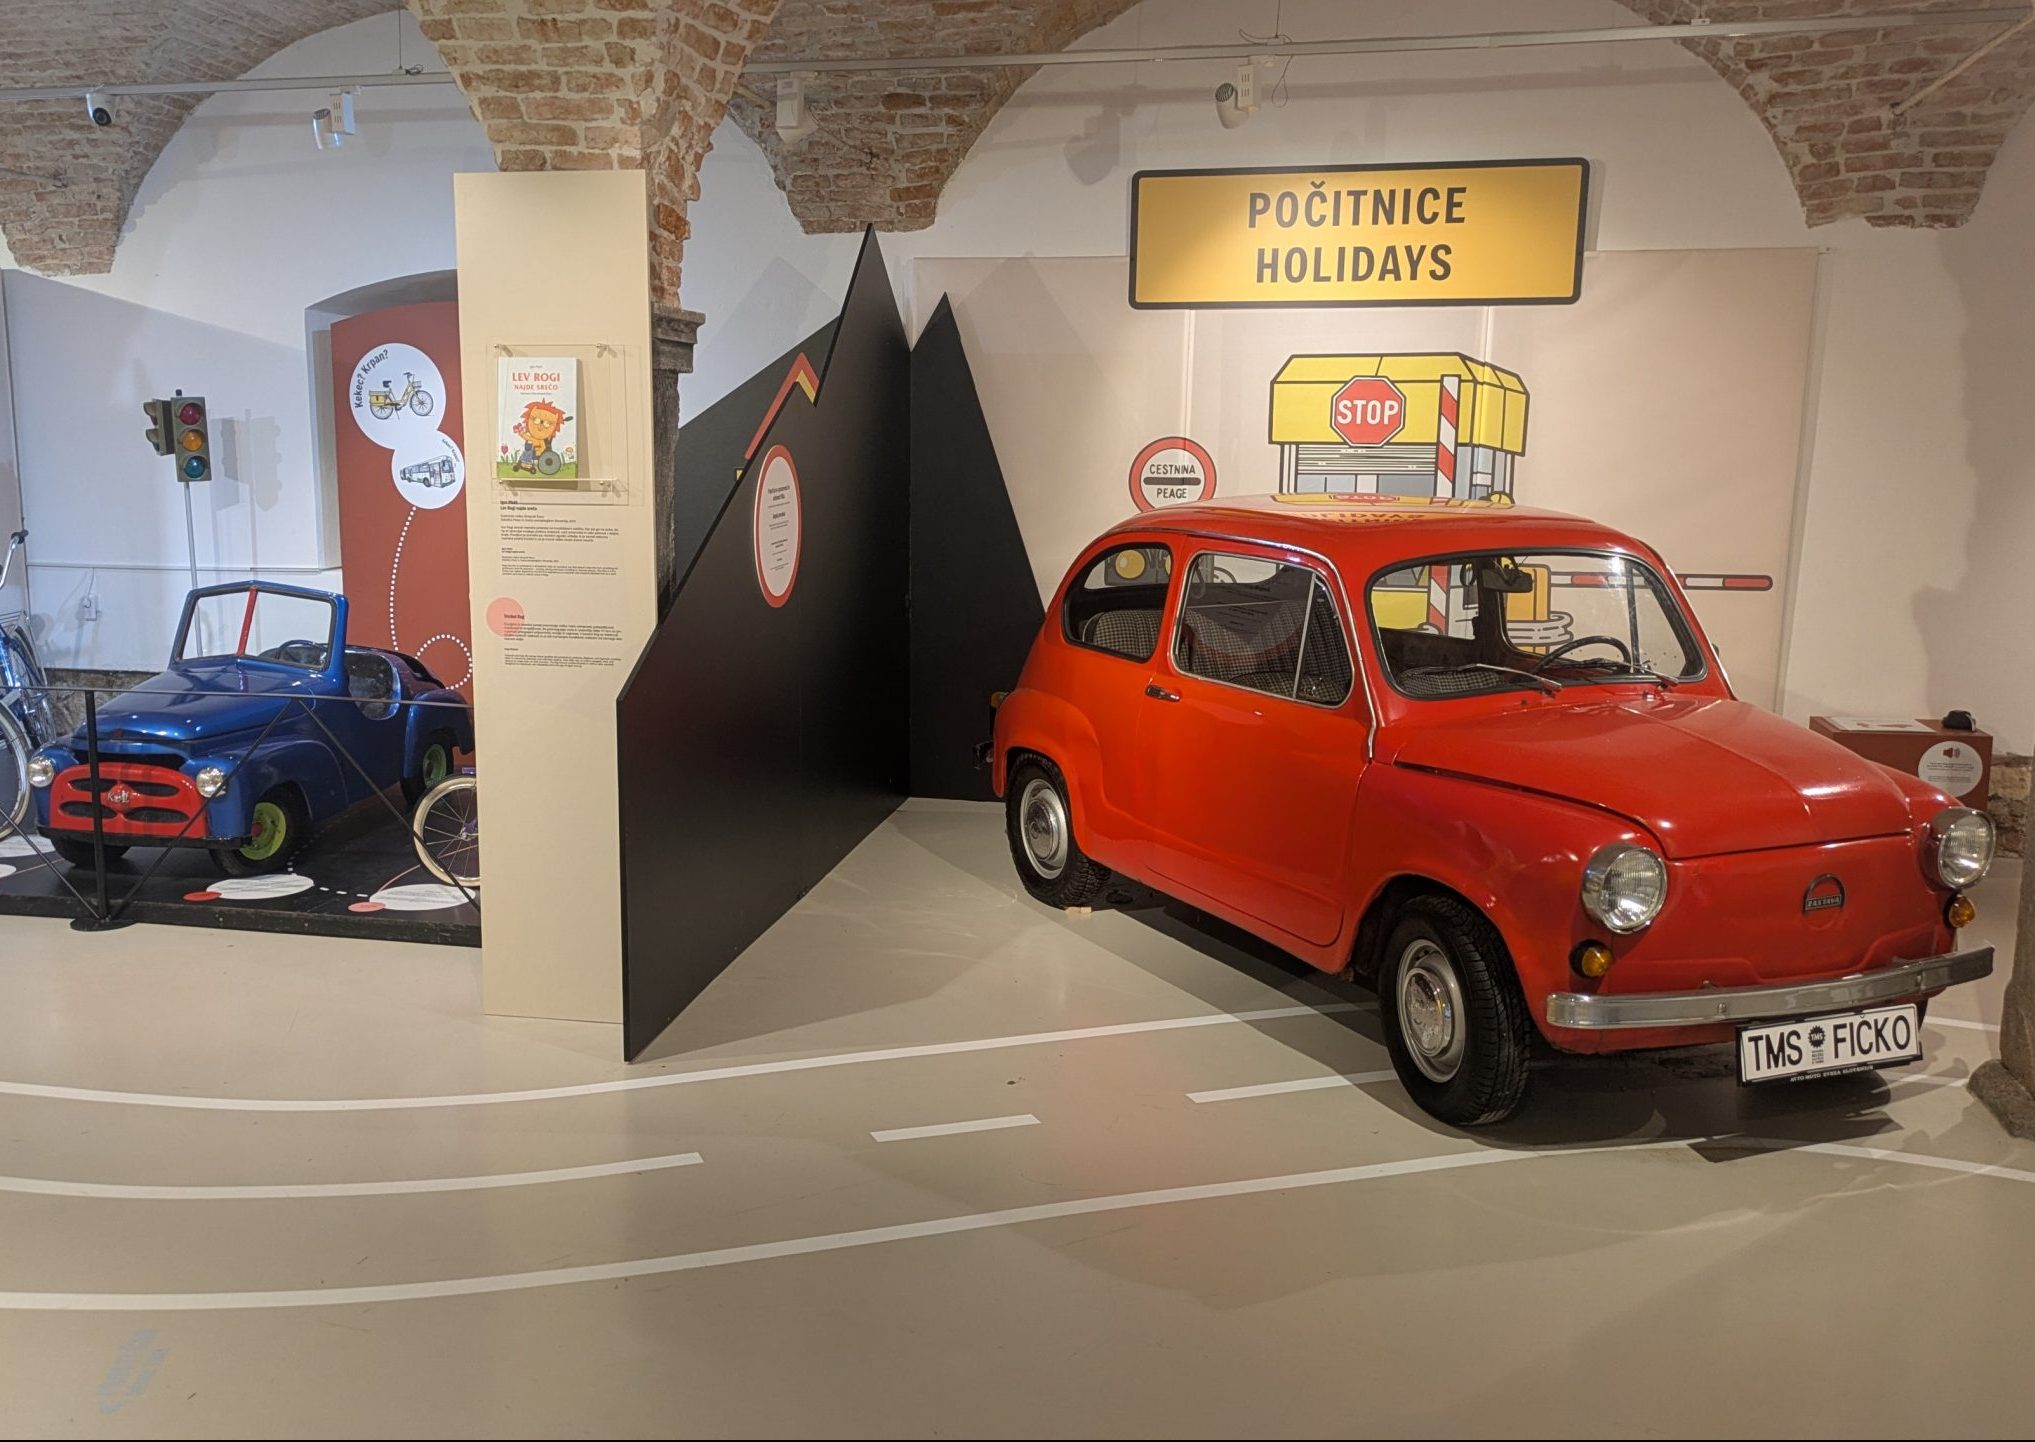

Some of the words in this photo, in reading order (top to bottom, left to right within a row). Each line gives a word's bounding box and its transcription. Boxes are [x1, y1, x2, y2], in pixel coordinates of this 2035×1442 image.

[1248, 180, 1467, 228] POČITNICE
[1256, 243, 1452, 283] HOLIDAYS
[353, 373, 365, 408] Kekec?
[361, 349, 388, 374] Krpan?
[512, 372, 530, 381] LEV
[534, 372, 560, 382] ROGI
[1337, 399, 1399, 424] STOP
[1149, 464, 1196, 475] CESTNINA
[1157, 488, 1187, 499] PEAGE
[1748, 1030, 1803, 1071] TMS
[1833, 1014, 1910, 1059] FIČKO
[1811, 1033, 1824, 1041] TMS
